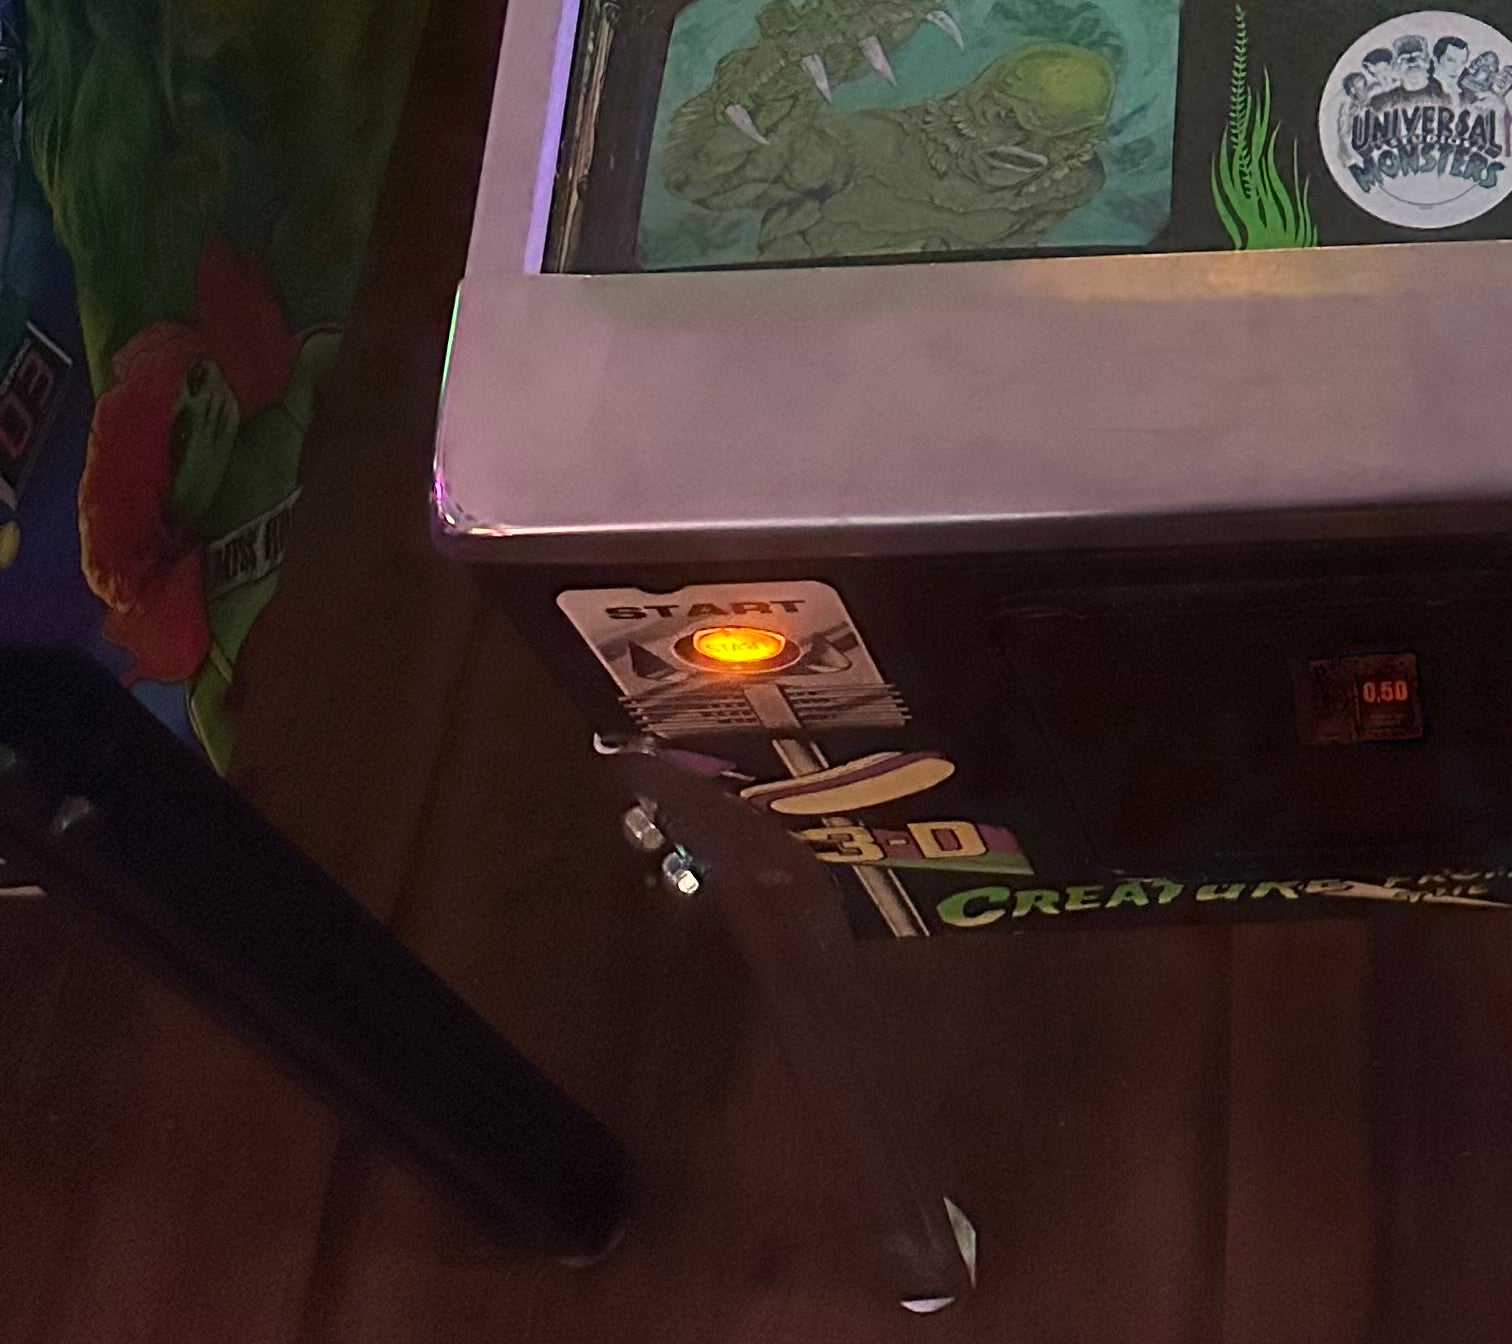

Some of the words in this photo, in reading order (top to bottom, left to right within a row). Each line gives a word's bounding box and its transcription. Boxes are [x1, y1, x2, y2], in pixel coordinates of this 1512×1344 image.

[1351, 104, 1503, 159] UNIVERSAL
[1347, 142, 1506, 194] MONSTERS
[604, 599, 806, 620] START
[1362, 680, 1409, 704] 0.50
[803, 820, 989, 864] 3-D
